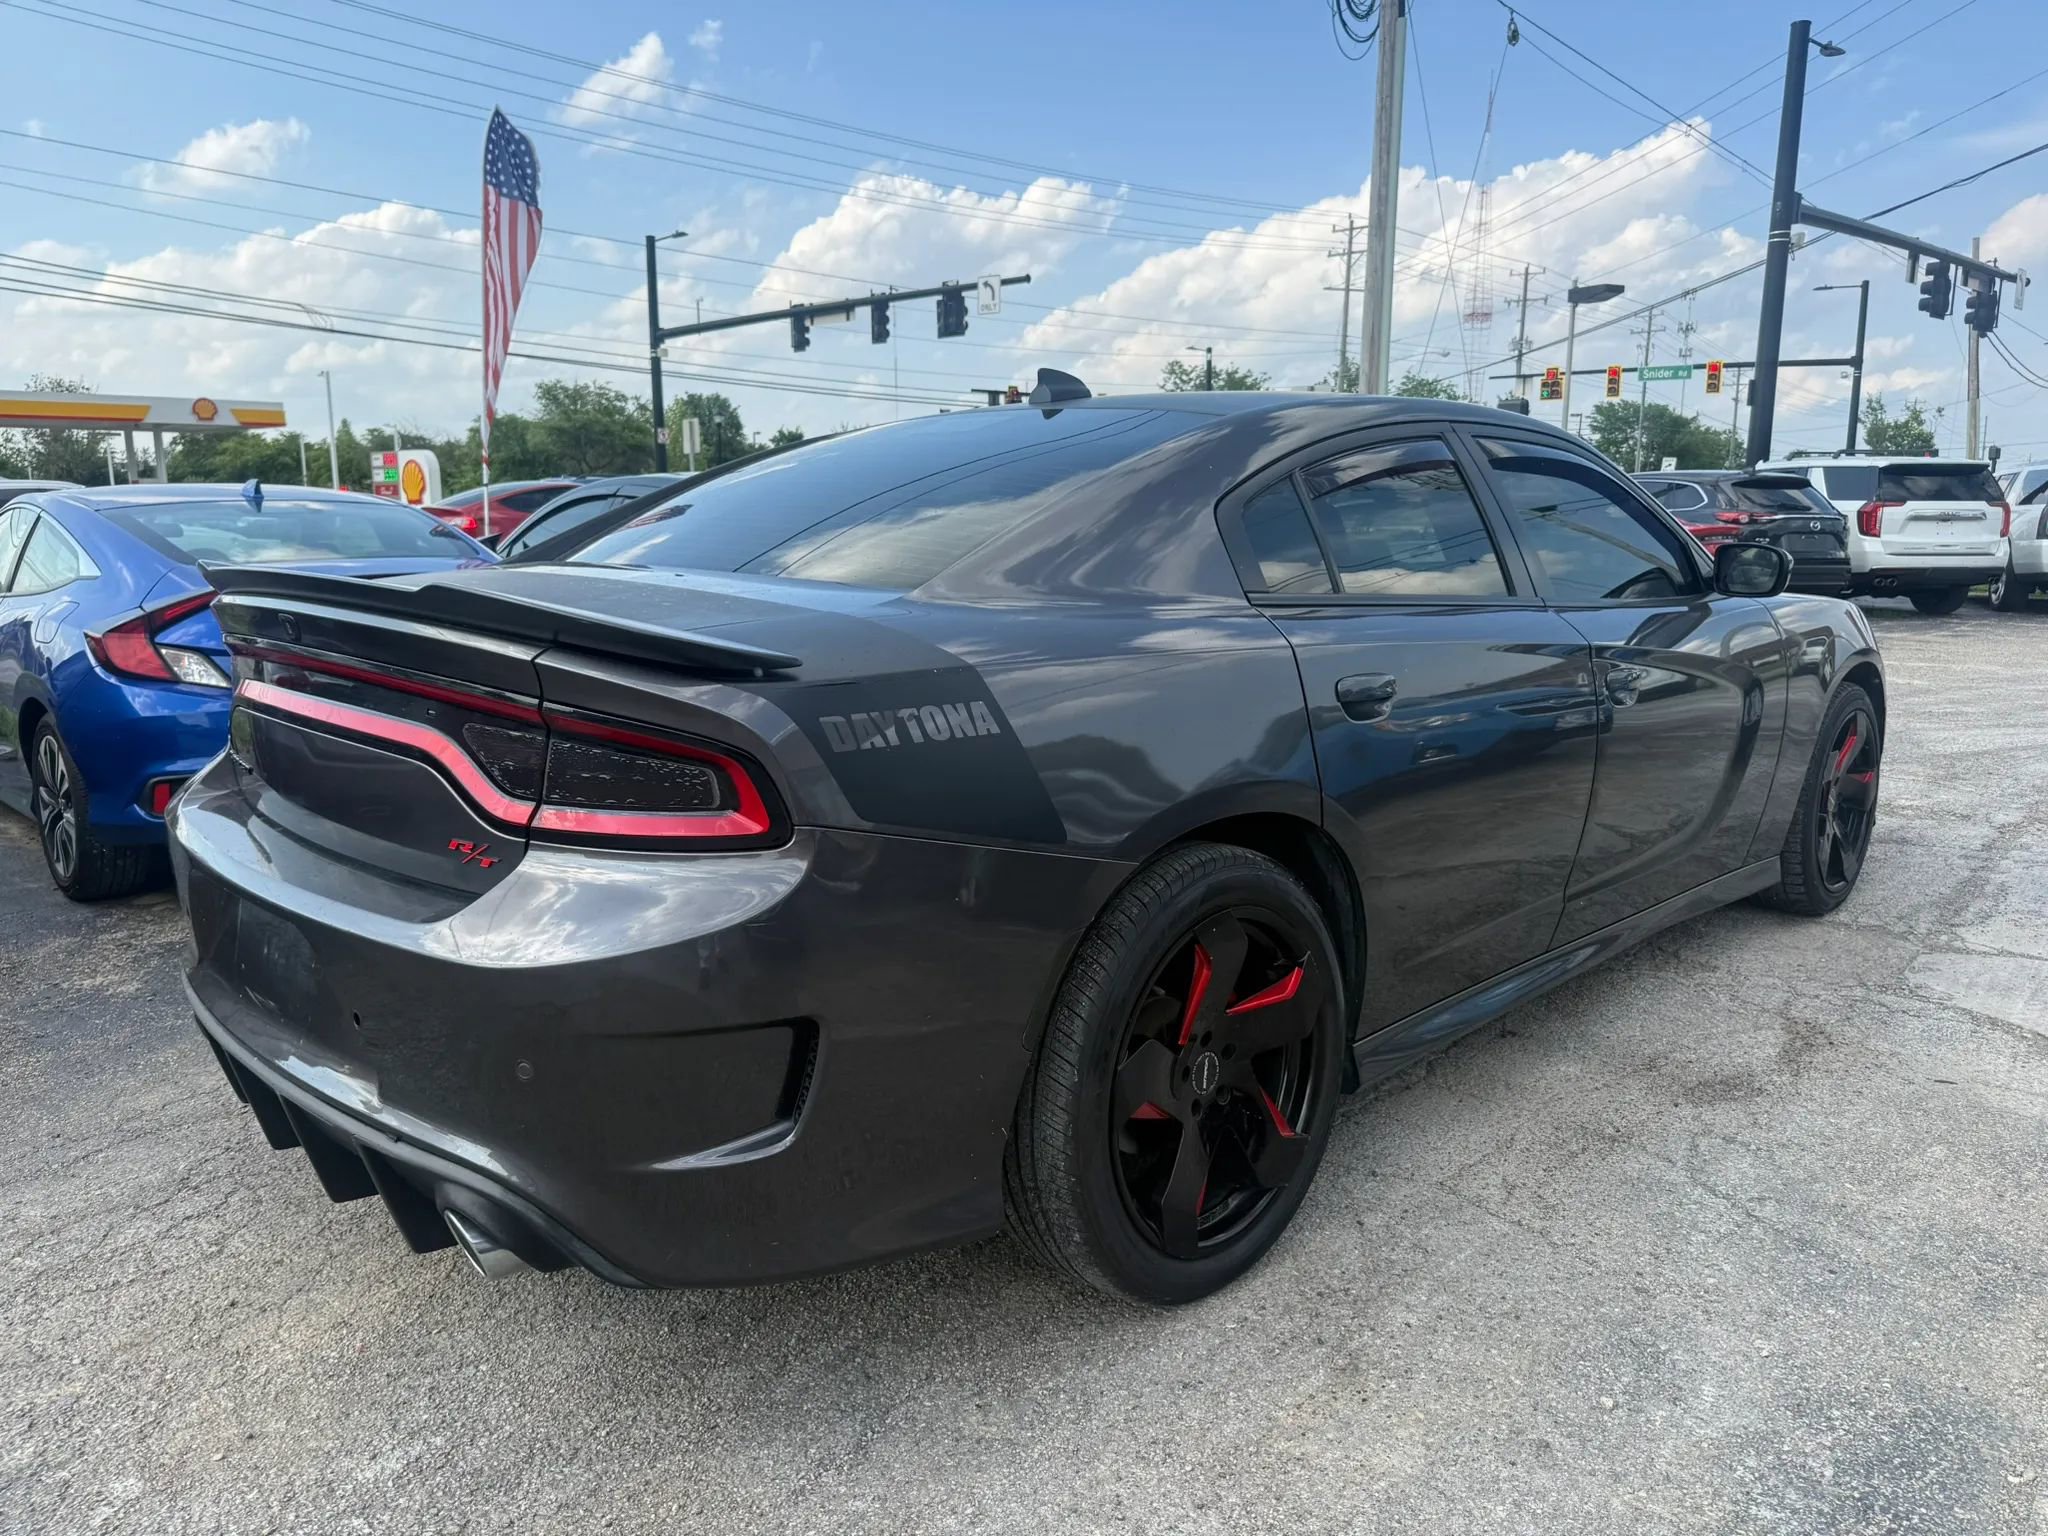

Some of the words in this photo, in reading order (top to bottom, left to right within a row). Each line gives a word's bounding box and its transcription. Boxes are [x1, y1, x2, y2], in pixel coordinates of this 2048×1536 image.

[980, 303, 997, 312] ONLY
[1643, 369, 1674, 379] Snider
[819, 701, 1000, 752] DAYTONA
[448, 839, 500, 868] R/T
